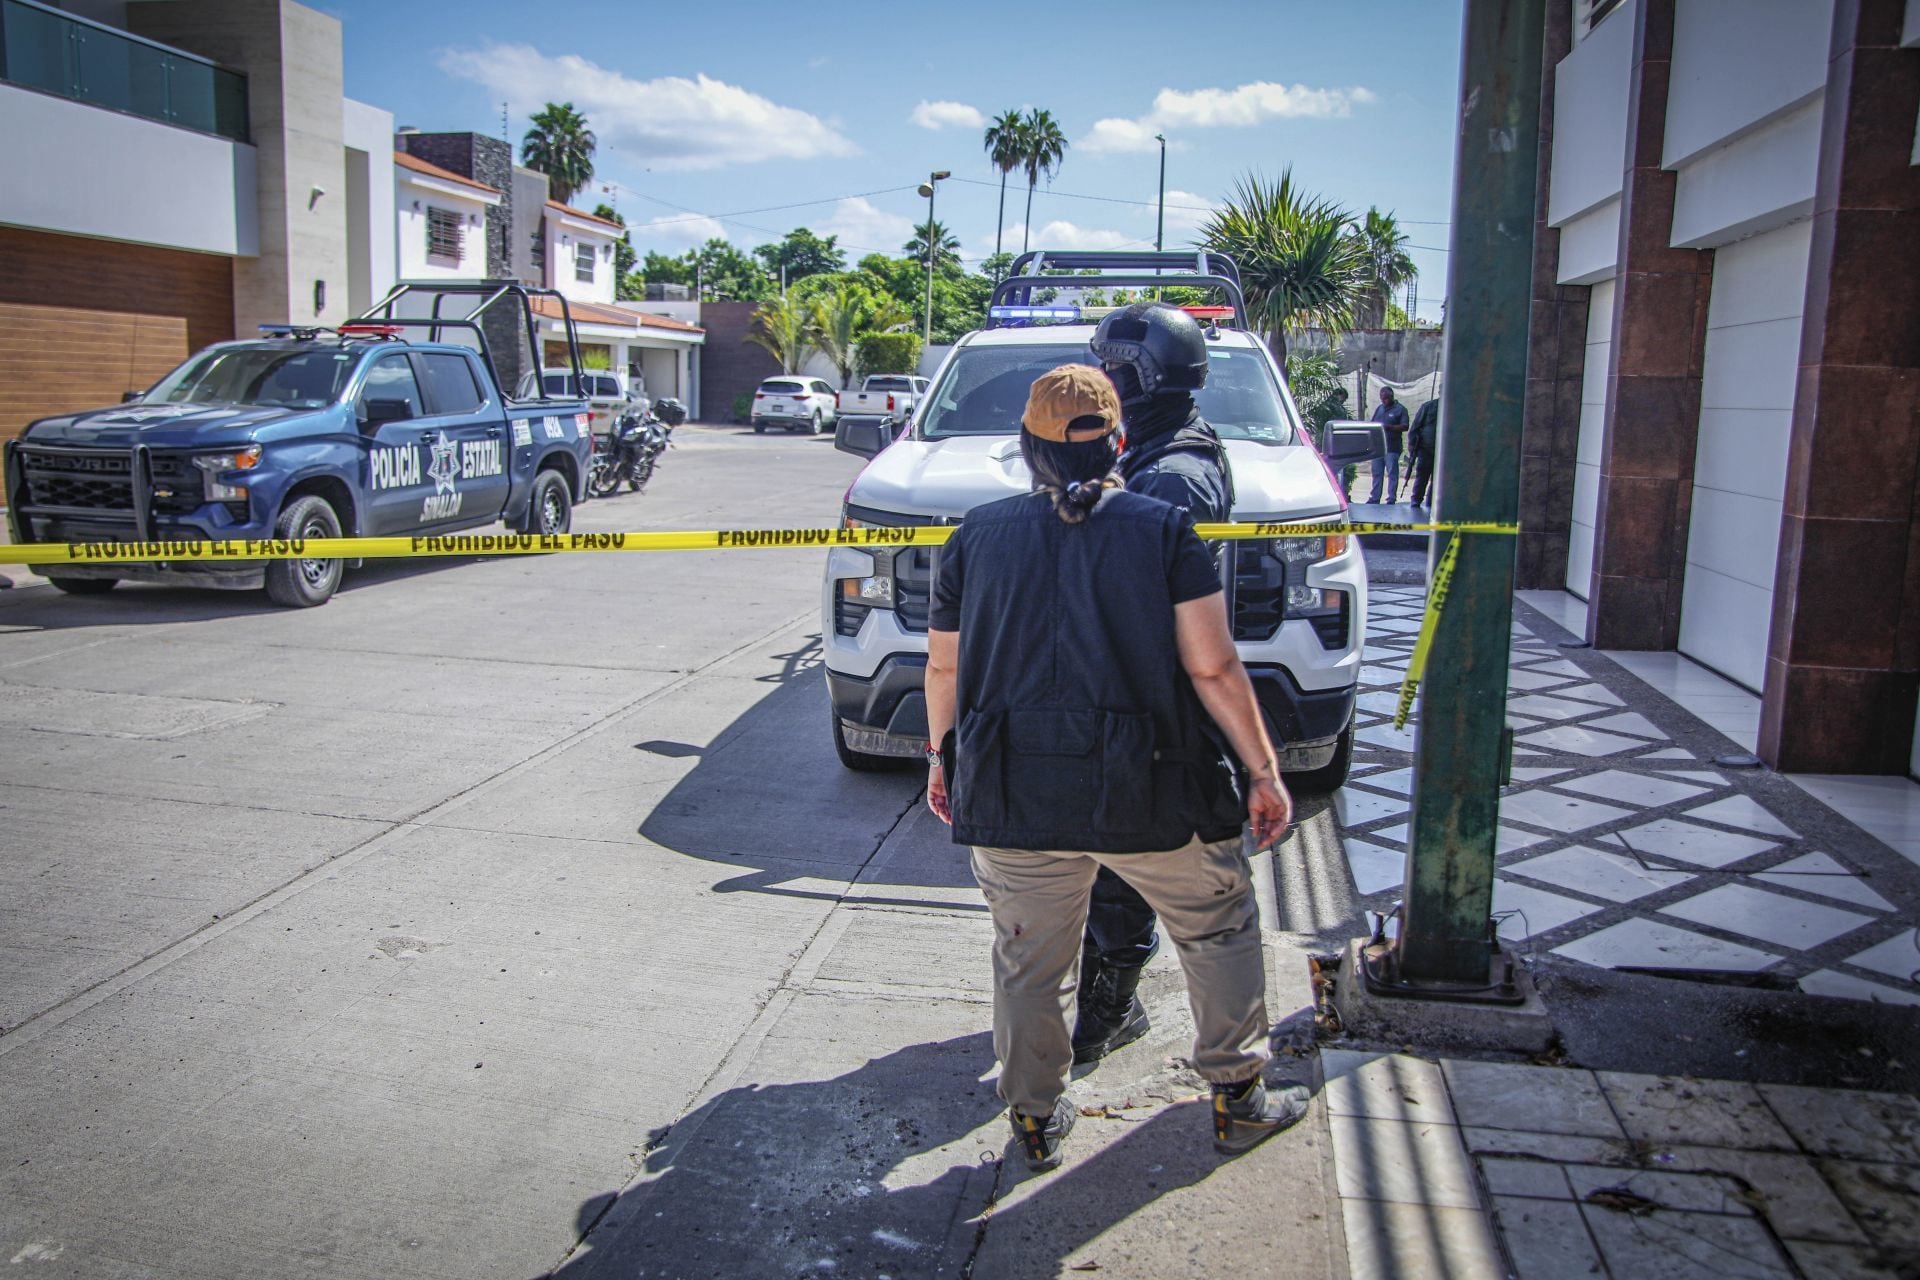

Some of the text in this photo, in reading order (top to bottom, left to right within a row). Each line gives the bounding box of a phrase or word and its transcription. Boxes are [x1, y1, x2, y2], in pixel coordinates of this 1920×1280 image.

[369, 439, 502, 490] POLICÍA ESTATAL
[419, 492, 462, 522] SINALOA
